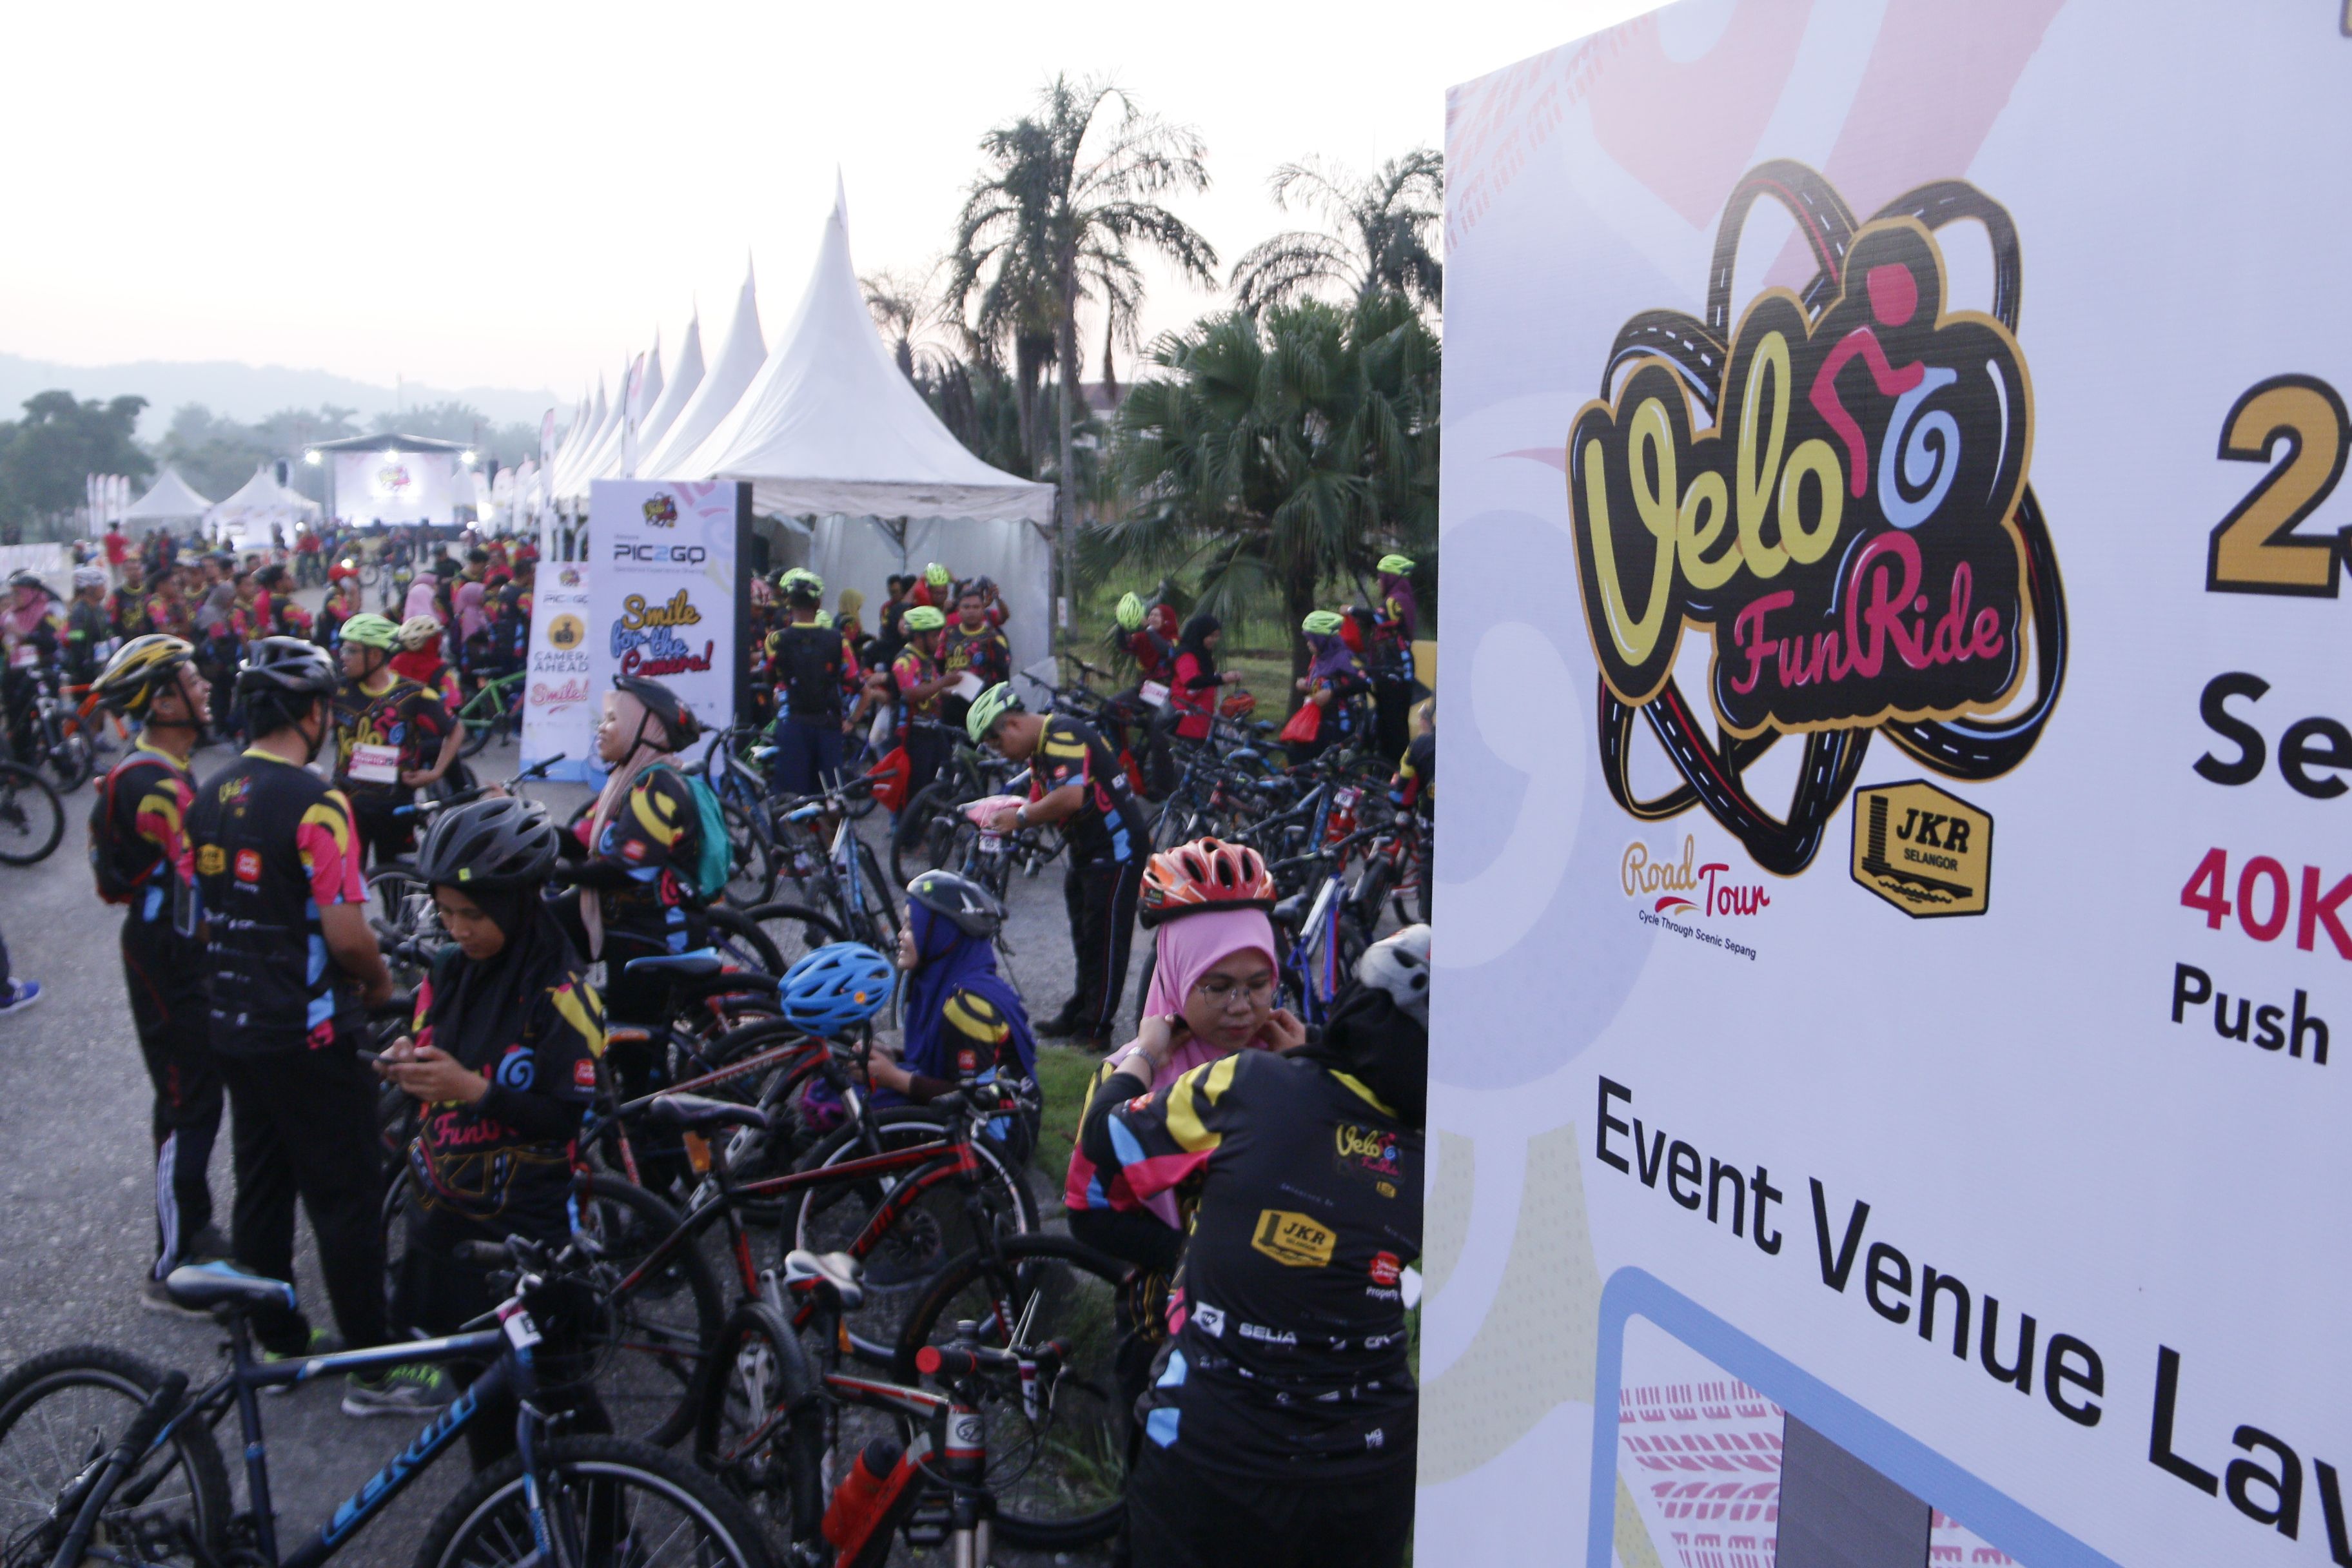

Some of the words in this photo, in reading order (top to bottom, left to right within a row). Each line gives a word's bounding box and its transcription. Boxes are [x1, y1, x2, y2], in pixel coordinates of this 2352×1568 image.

[1585, 331, 1843, 667] Velo
[614, 544, 706, 565] PIC2GO
[622, 588, 701, 631] Smile
[649, 625, 689, 658] the
[531, 678, 589, 706] Smile!
[1897, 808, 1970, 854] JKR
[1622, 834, 1697, 896] Road
[1698, 863, 1770, 917] Tour
[1904, 848, 1958, 872] SELANGOR
[1639, 909, 1660, 926] Cycle
[1661, 916, 1694, 939] Through
[1695, 928, 1723, 948] Scenic
[1725, 938, 1757, 961] Sepang
[2171, 962, 2329, 1066] Push
[1336, 1124, 1381, 1158] Velo
[1283, 1222, 1326, 1246] JKR
[1596, 1074, 1783, 1256] Event
[1808, 1175, 2105, 1429] Venue
